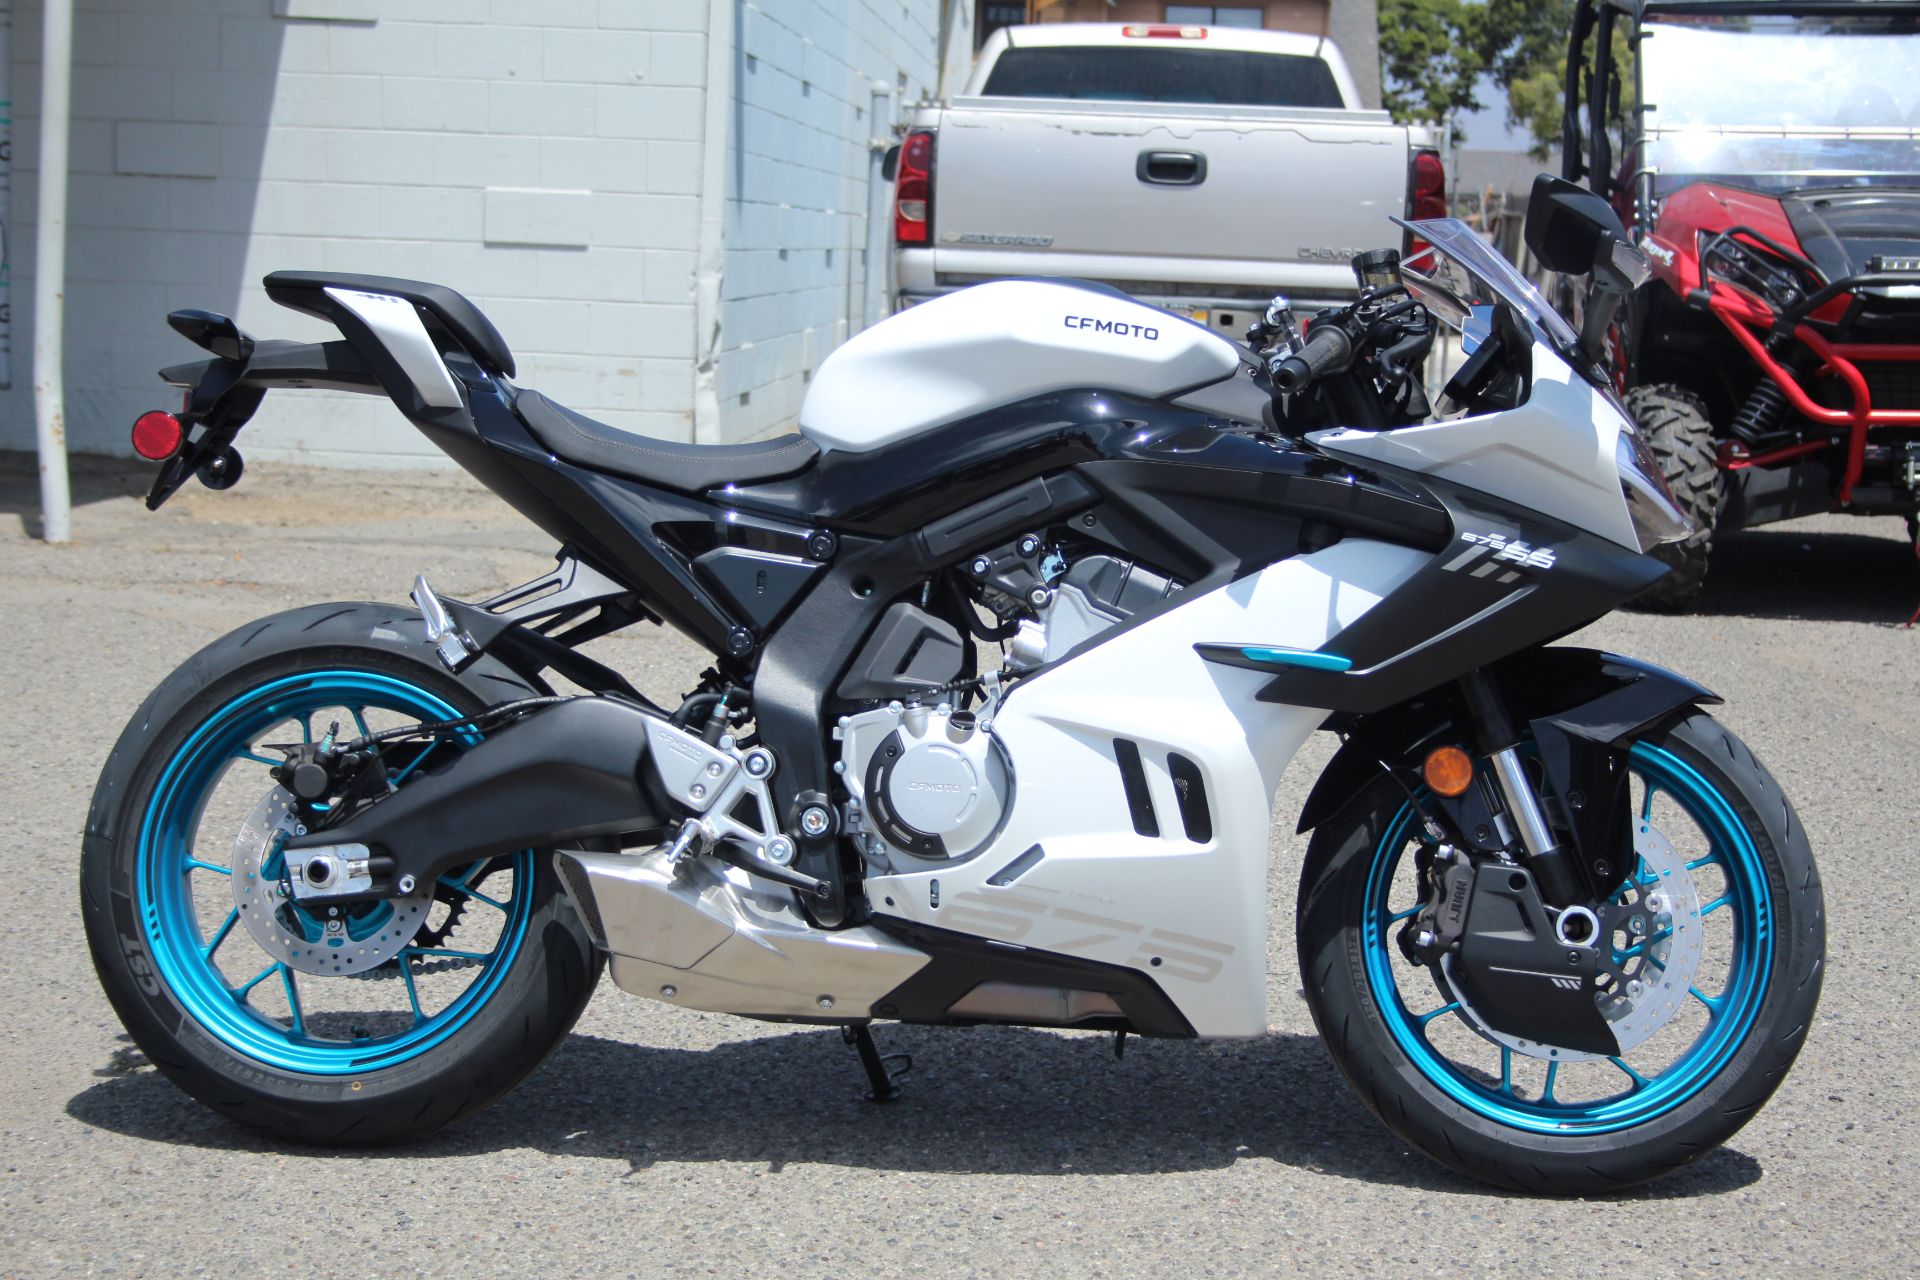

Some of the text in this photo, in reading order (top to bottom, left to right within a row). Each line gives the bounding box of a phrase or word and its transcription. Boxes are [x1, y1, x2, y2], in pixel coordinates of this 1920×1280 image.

[1064, 315, 1159, 341] CFMOTO
[907, 781, 961, 793] CFMOTO
[935, 891, 1236, 984] 675
[119, 932, 160, 997] CST
